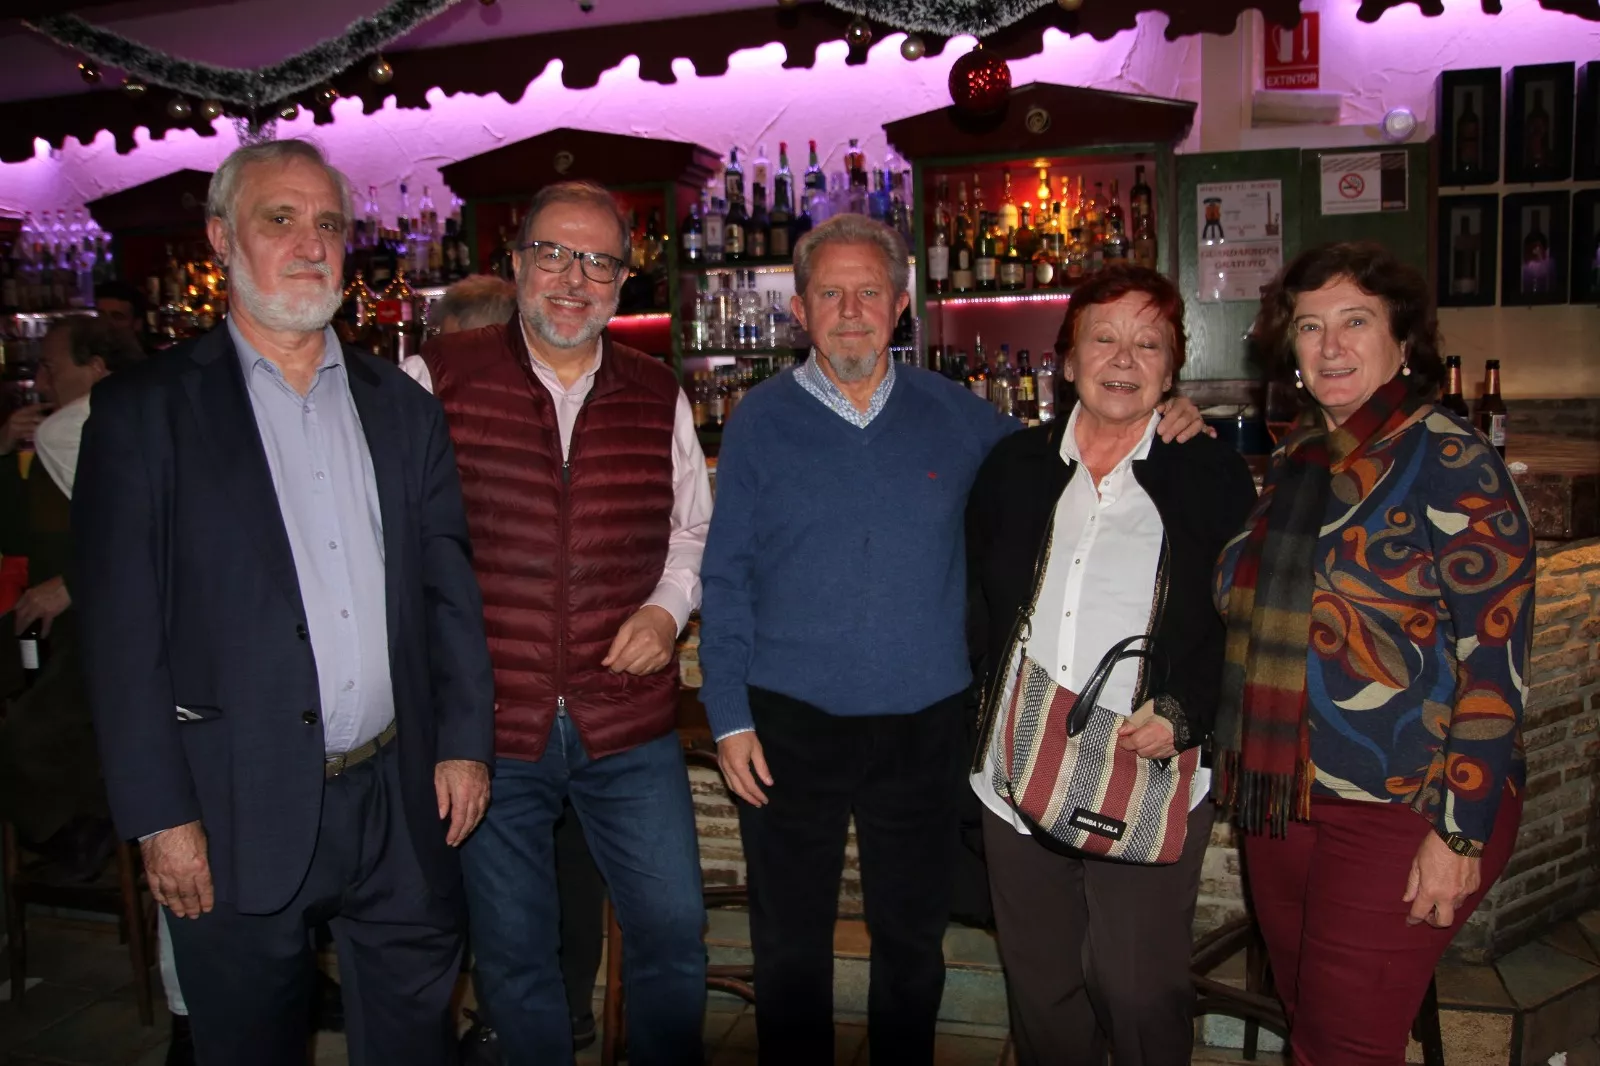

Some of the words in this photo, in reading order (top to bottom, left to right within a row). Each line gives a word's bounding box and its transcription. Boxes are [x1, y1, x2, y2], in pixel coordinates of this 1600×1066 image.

[1267, 72, 1317, 86] EXTINTOR
[1076, 816, 1097, 828] BIMBA
[1102, 824, 1118, 834] LOLA
